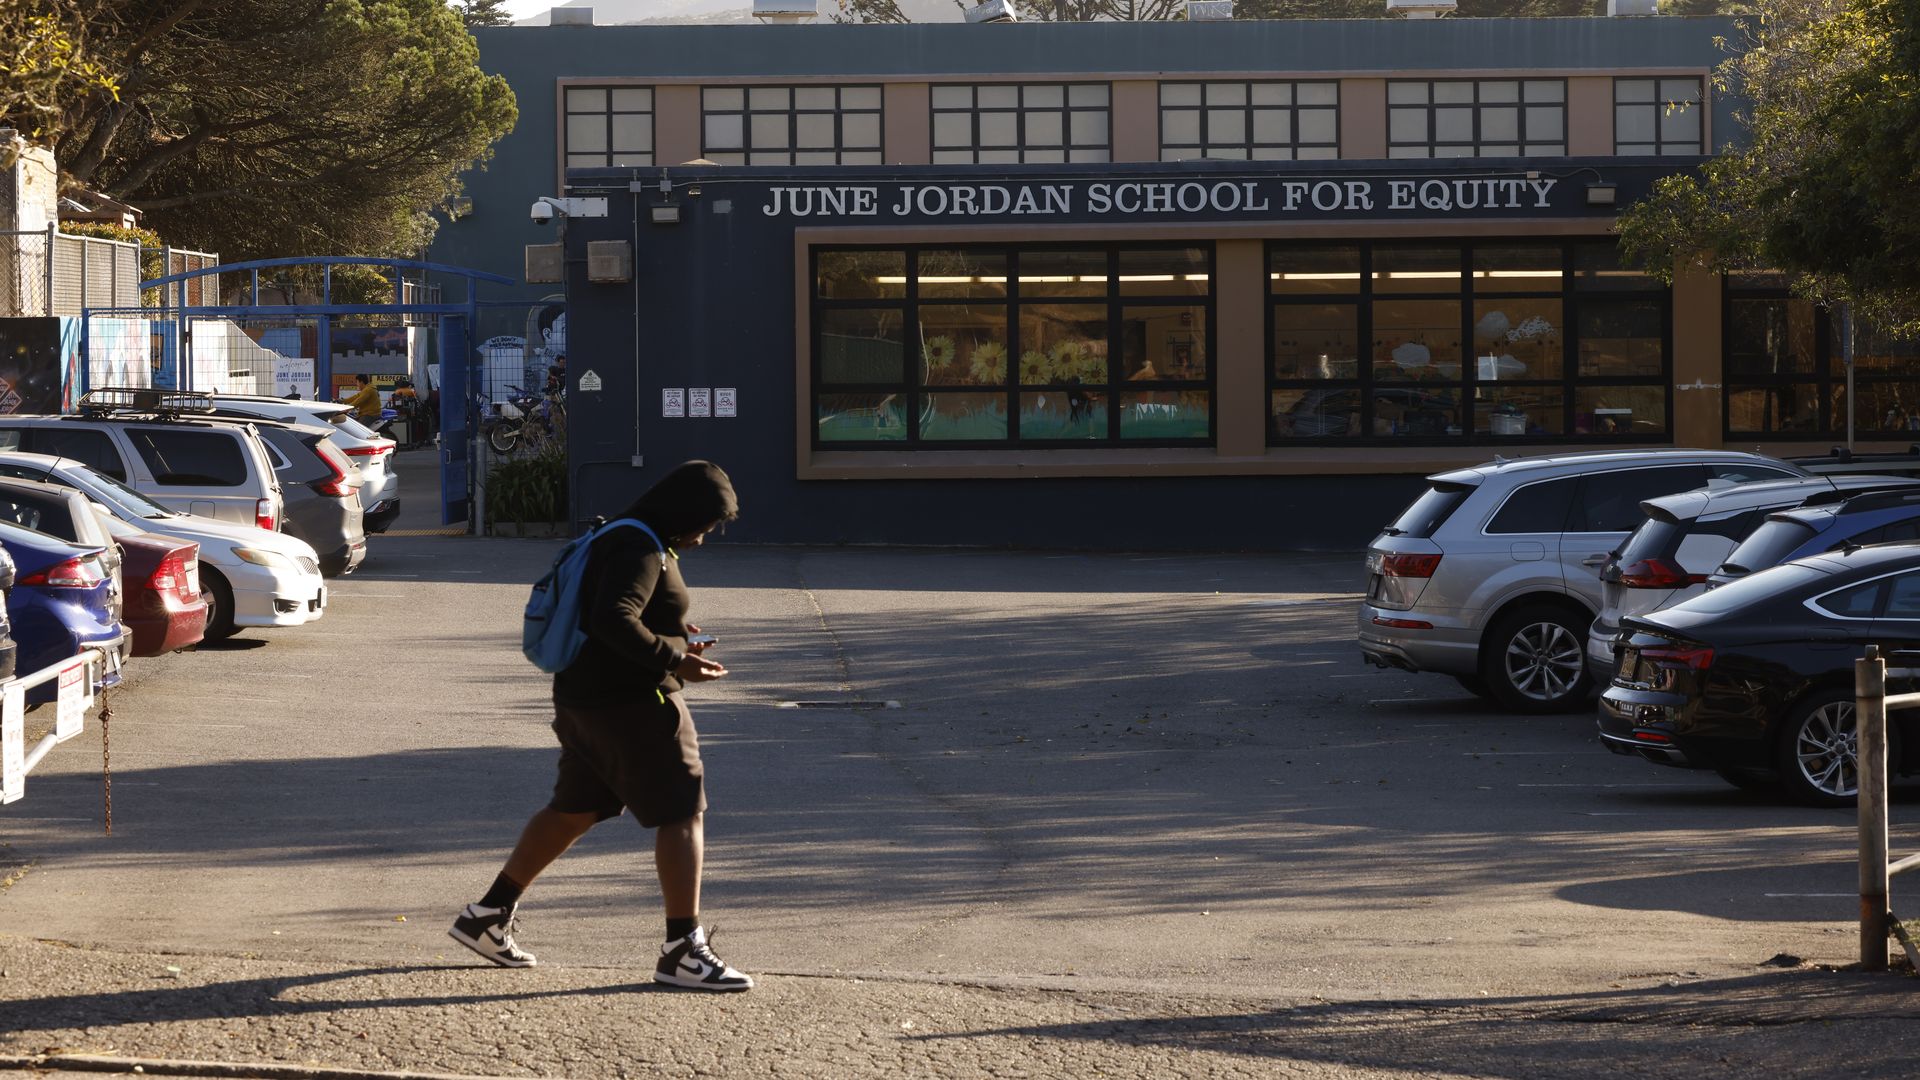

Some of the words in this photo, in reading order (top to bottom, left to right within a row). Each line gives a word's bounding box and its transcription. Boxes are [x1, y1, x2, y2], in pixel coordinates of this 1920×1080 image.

[762, 187, 877, 216] JUNE
[893, 185, 1074, 215] JORDAN
[1088, 182, 1269, 213] SCHOOL
[1282, 181, 1374, 211] FOR
[1387, 179, 1558, 211] EQUITY
